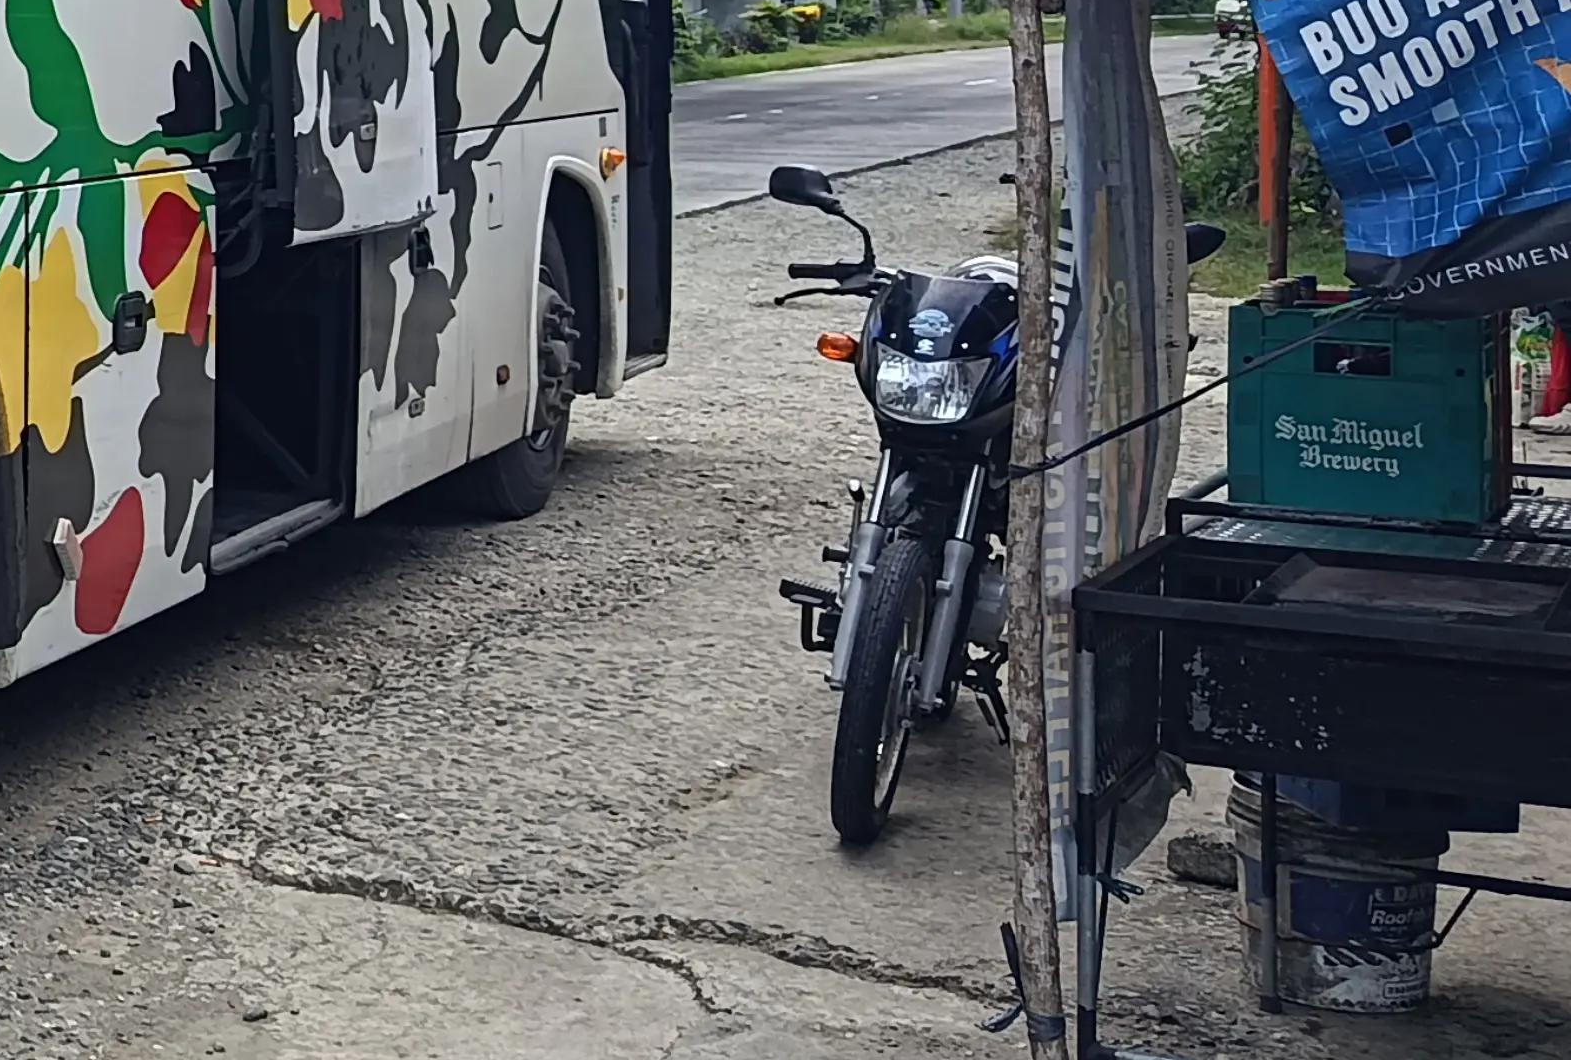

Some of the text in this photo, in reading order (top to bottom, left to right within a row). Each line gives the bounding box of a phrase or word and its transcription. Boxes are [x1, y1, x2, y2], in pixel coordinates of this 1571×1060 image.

[1388, 242, 1571, 300] OVERNMEN
[1275, 415, 1423, 450] San Miguel
[1299, 444, 1400, 477] Brewery
